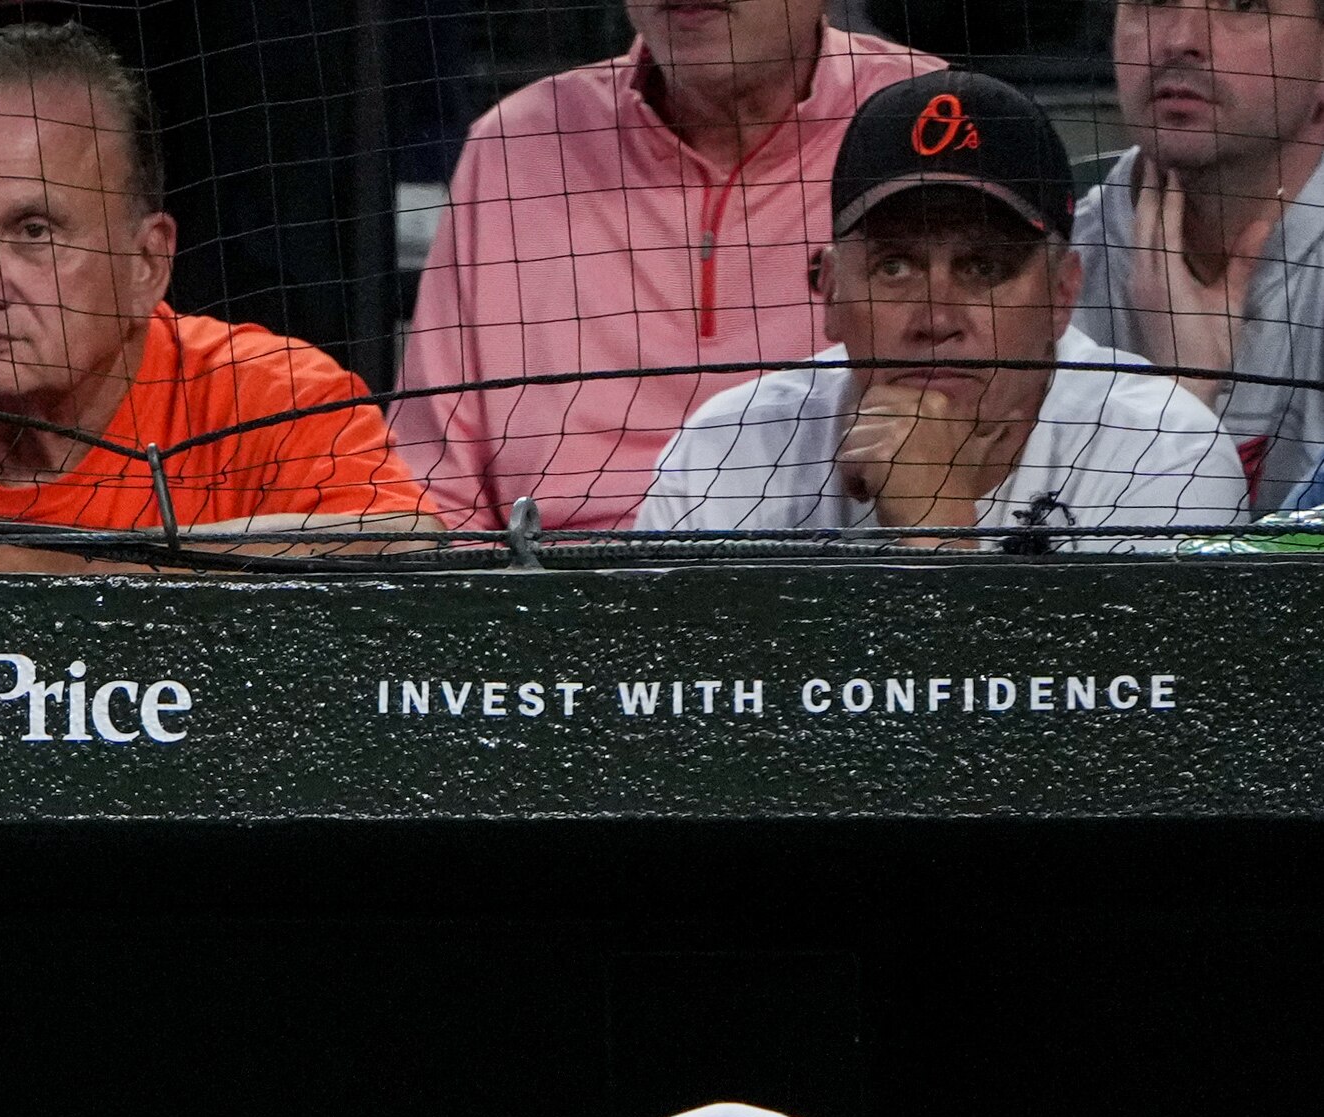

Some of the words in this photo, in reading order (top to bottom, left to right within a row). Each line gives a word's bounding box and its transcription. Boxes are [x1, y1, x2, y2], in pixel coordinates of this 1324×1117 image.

[378, 680, 583, 718] INVEST
[618, 679, 764, 716] WITH
[802, 674, 1177, 714] CONFIDENCE
